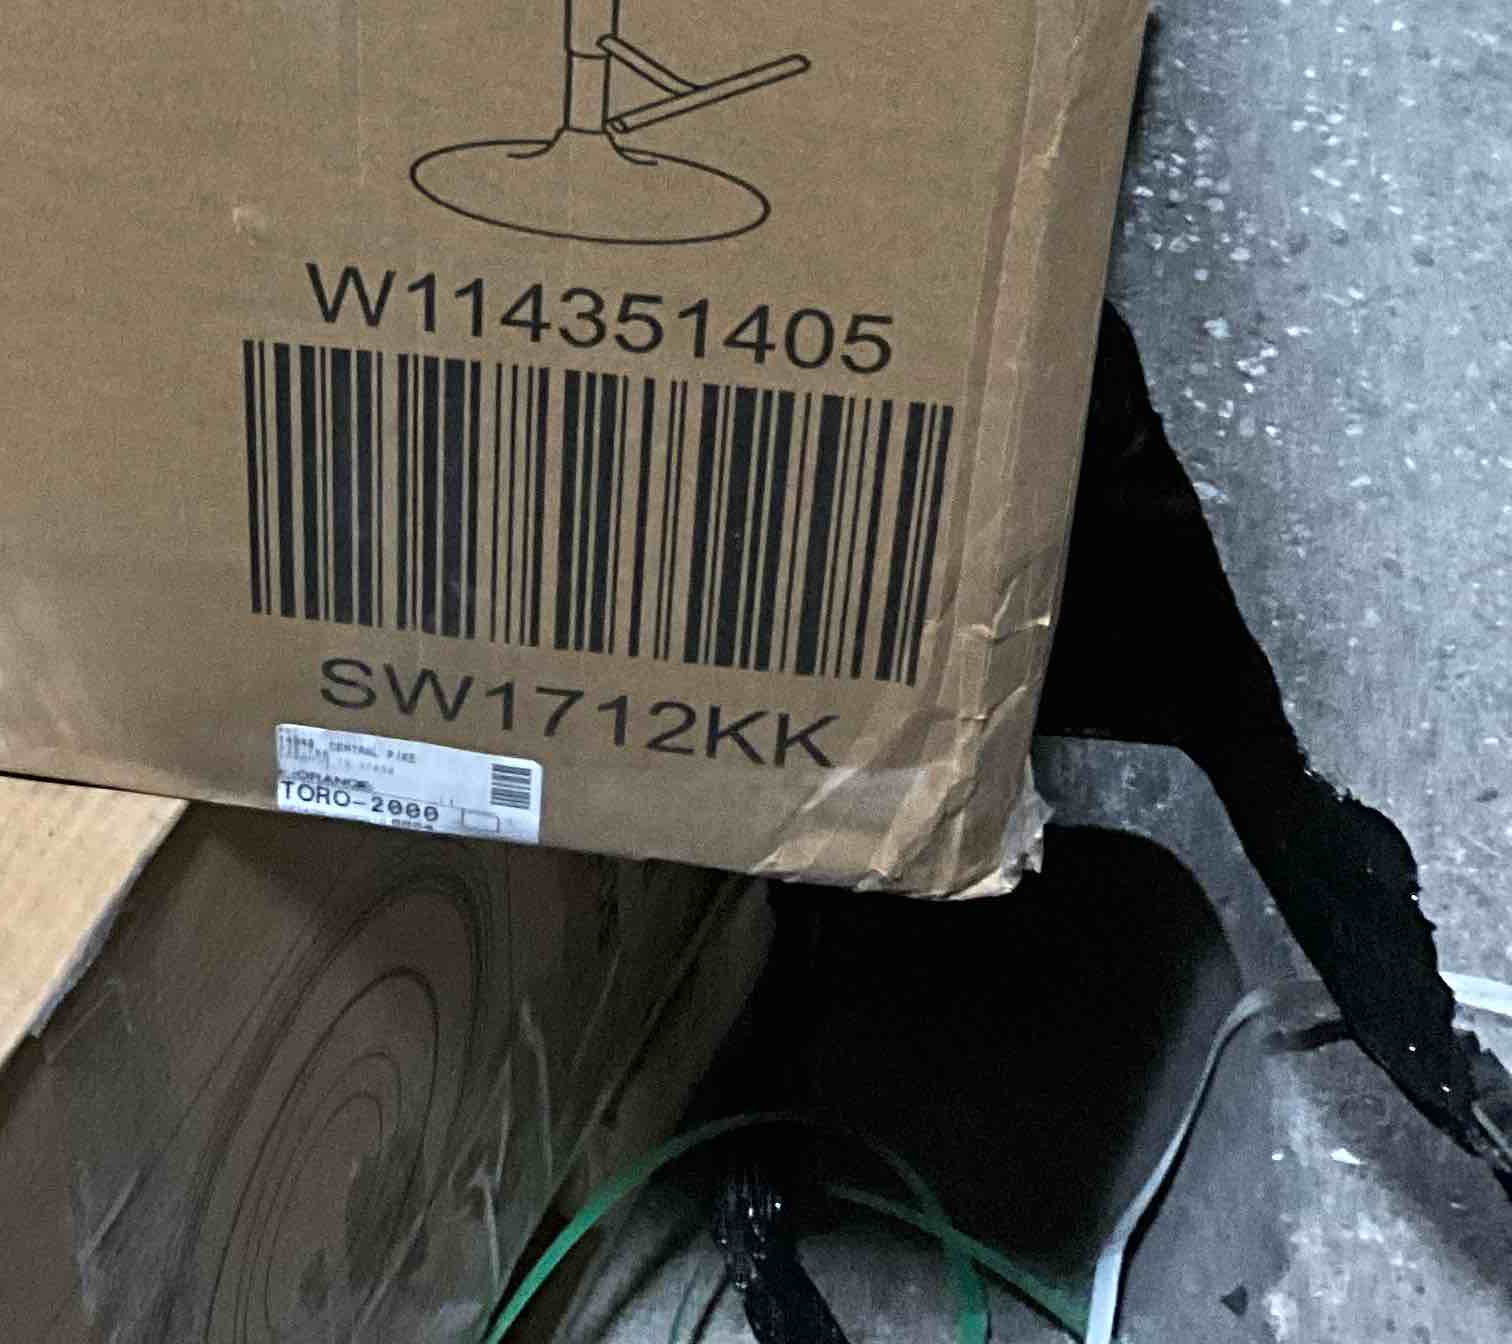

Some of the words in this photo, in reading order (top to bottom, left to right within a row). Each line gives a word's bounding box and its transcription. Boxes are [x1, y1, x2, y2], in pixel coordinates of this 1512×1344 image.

[305, 262, 895, 375] W114351405
[319, 658, 841, 769] SW1712KK
[280, 780, 439, 822] TORO-2000
